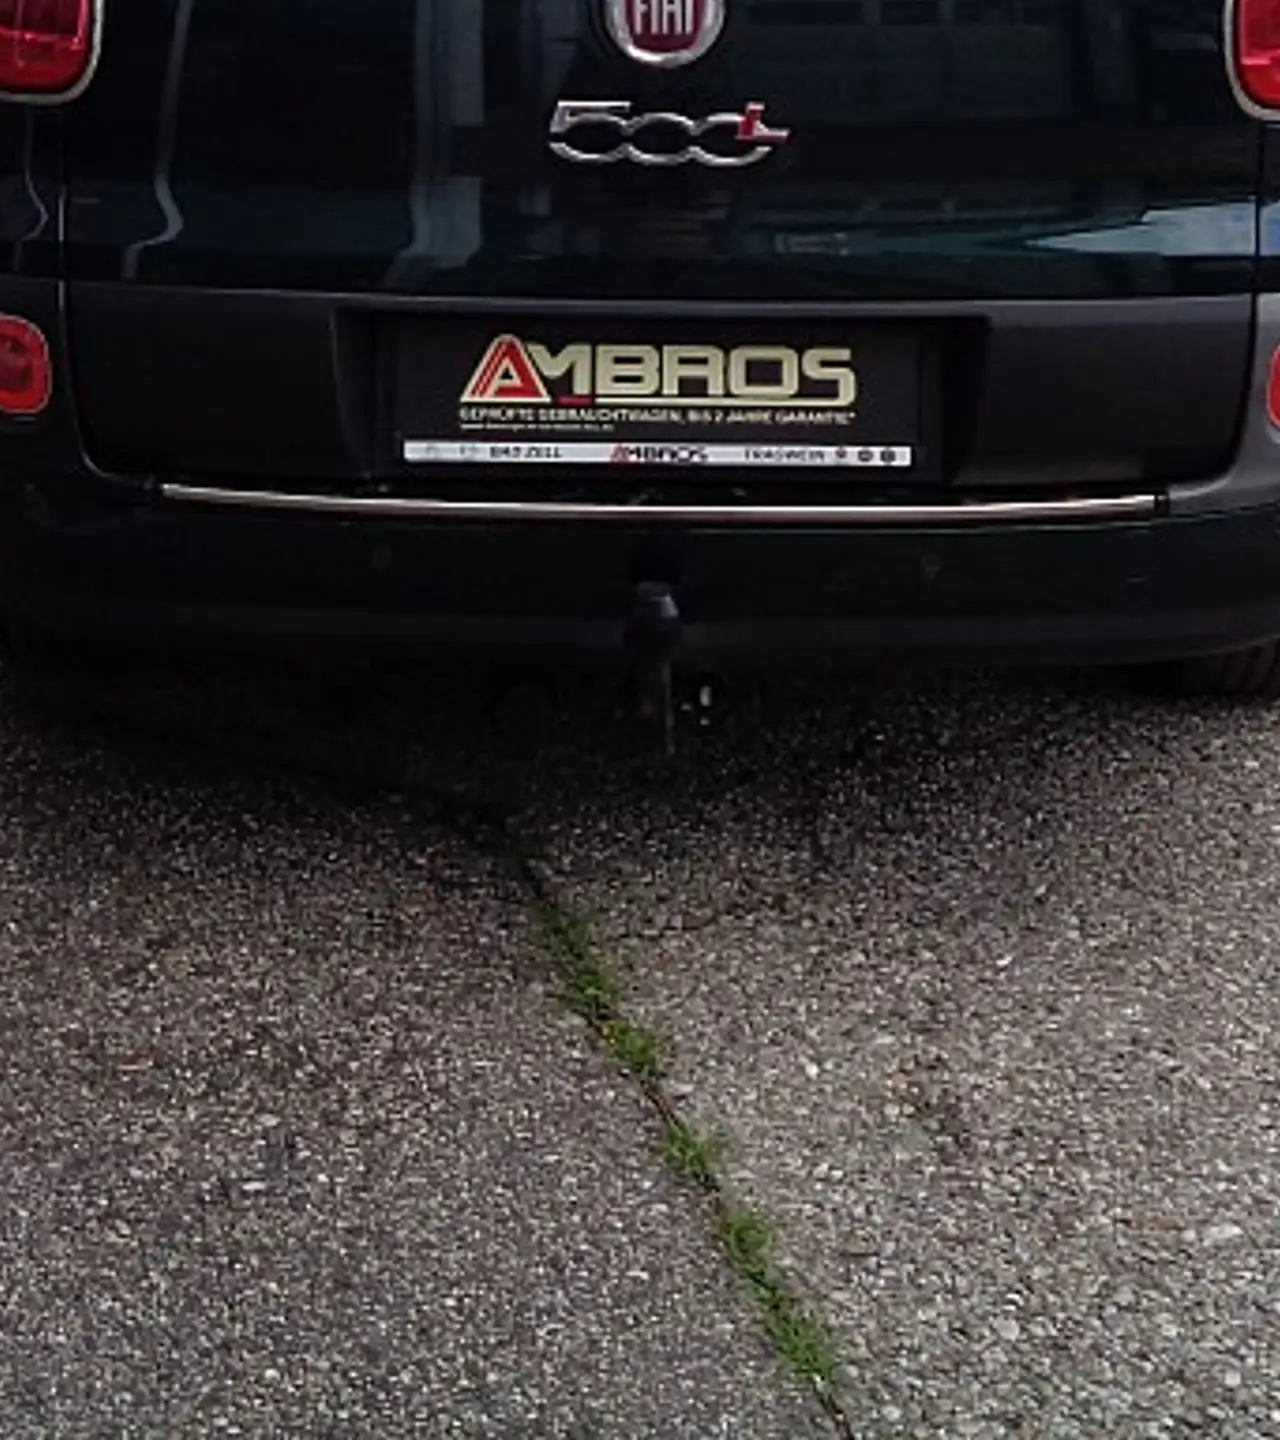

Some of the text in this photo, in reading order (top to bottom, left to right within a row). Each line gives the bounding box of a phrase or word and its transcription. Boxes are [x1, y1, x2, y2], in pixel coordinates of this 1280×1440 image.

[549, 100, 791, 166] 500L
[460, 333, 857, 407] AMBROS
[611, 444, 708, 464] AMBROS
